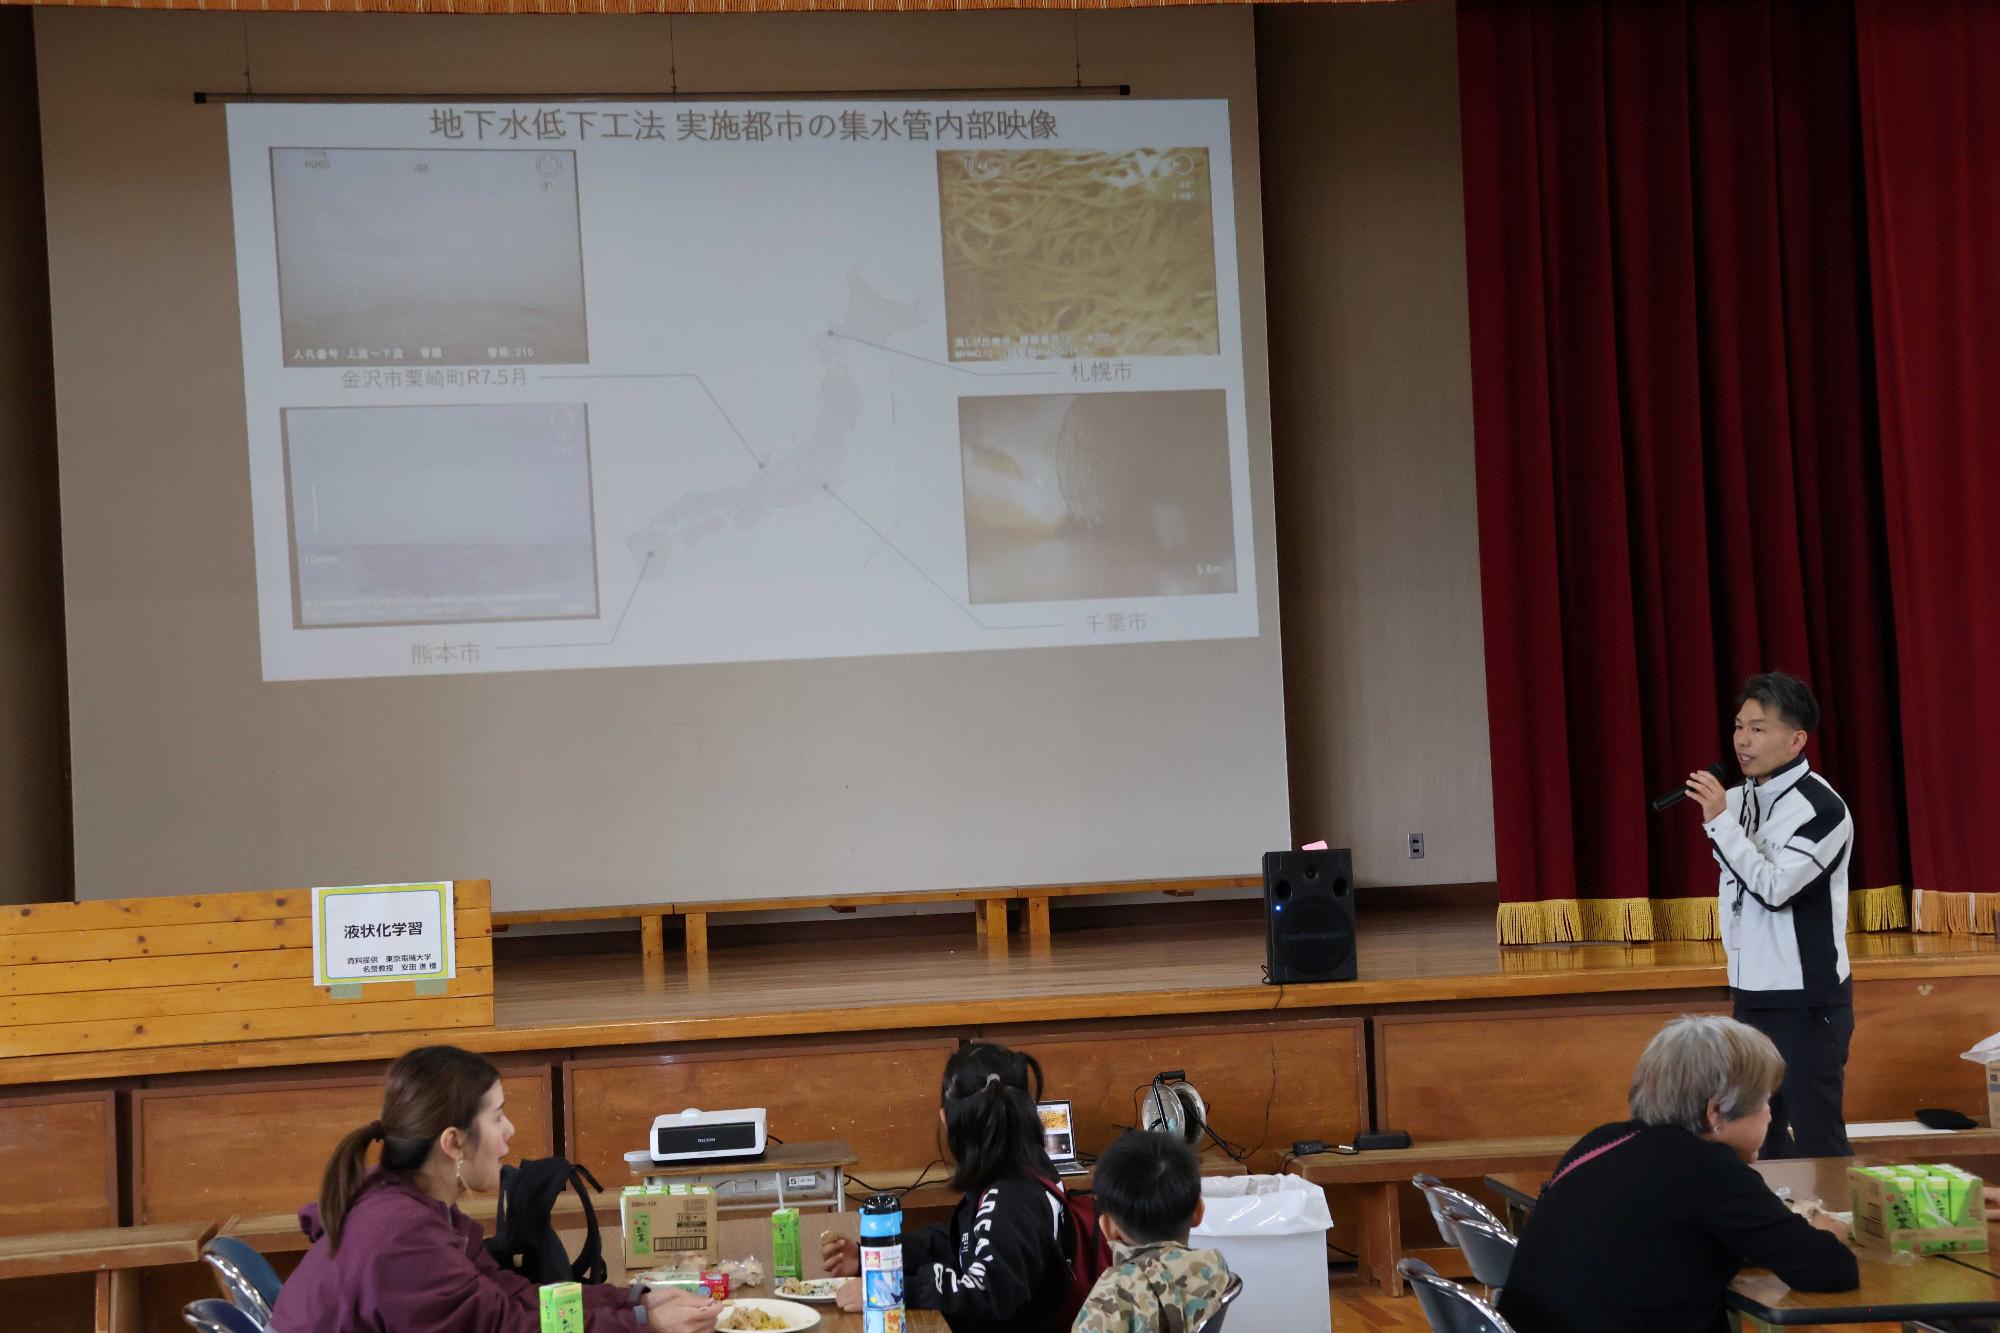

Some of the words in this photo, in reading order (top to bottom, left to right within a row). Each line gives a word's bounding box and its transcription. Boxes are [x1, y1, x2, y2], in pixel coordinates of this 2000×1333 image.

[430, 108, 665, 141] 地下水低下工法
[676, 108, 1059, 141] 実施都市の集水管内部映像
[1070, 361, 1132, 382] 札幌市
[1085, 611, 1147, 633] 千葉市
[410, 641, 480, 664] 熊本市
[344, 921, 423, 939] 液状化学習
